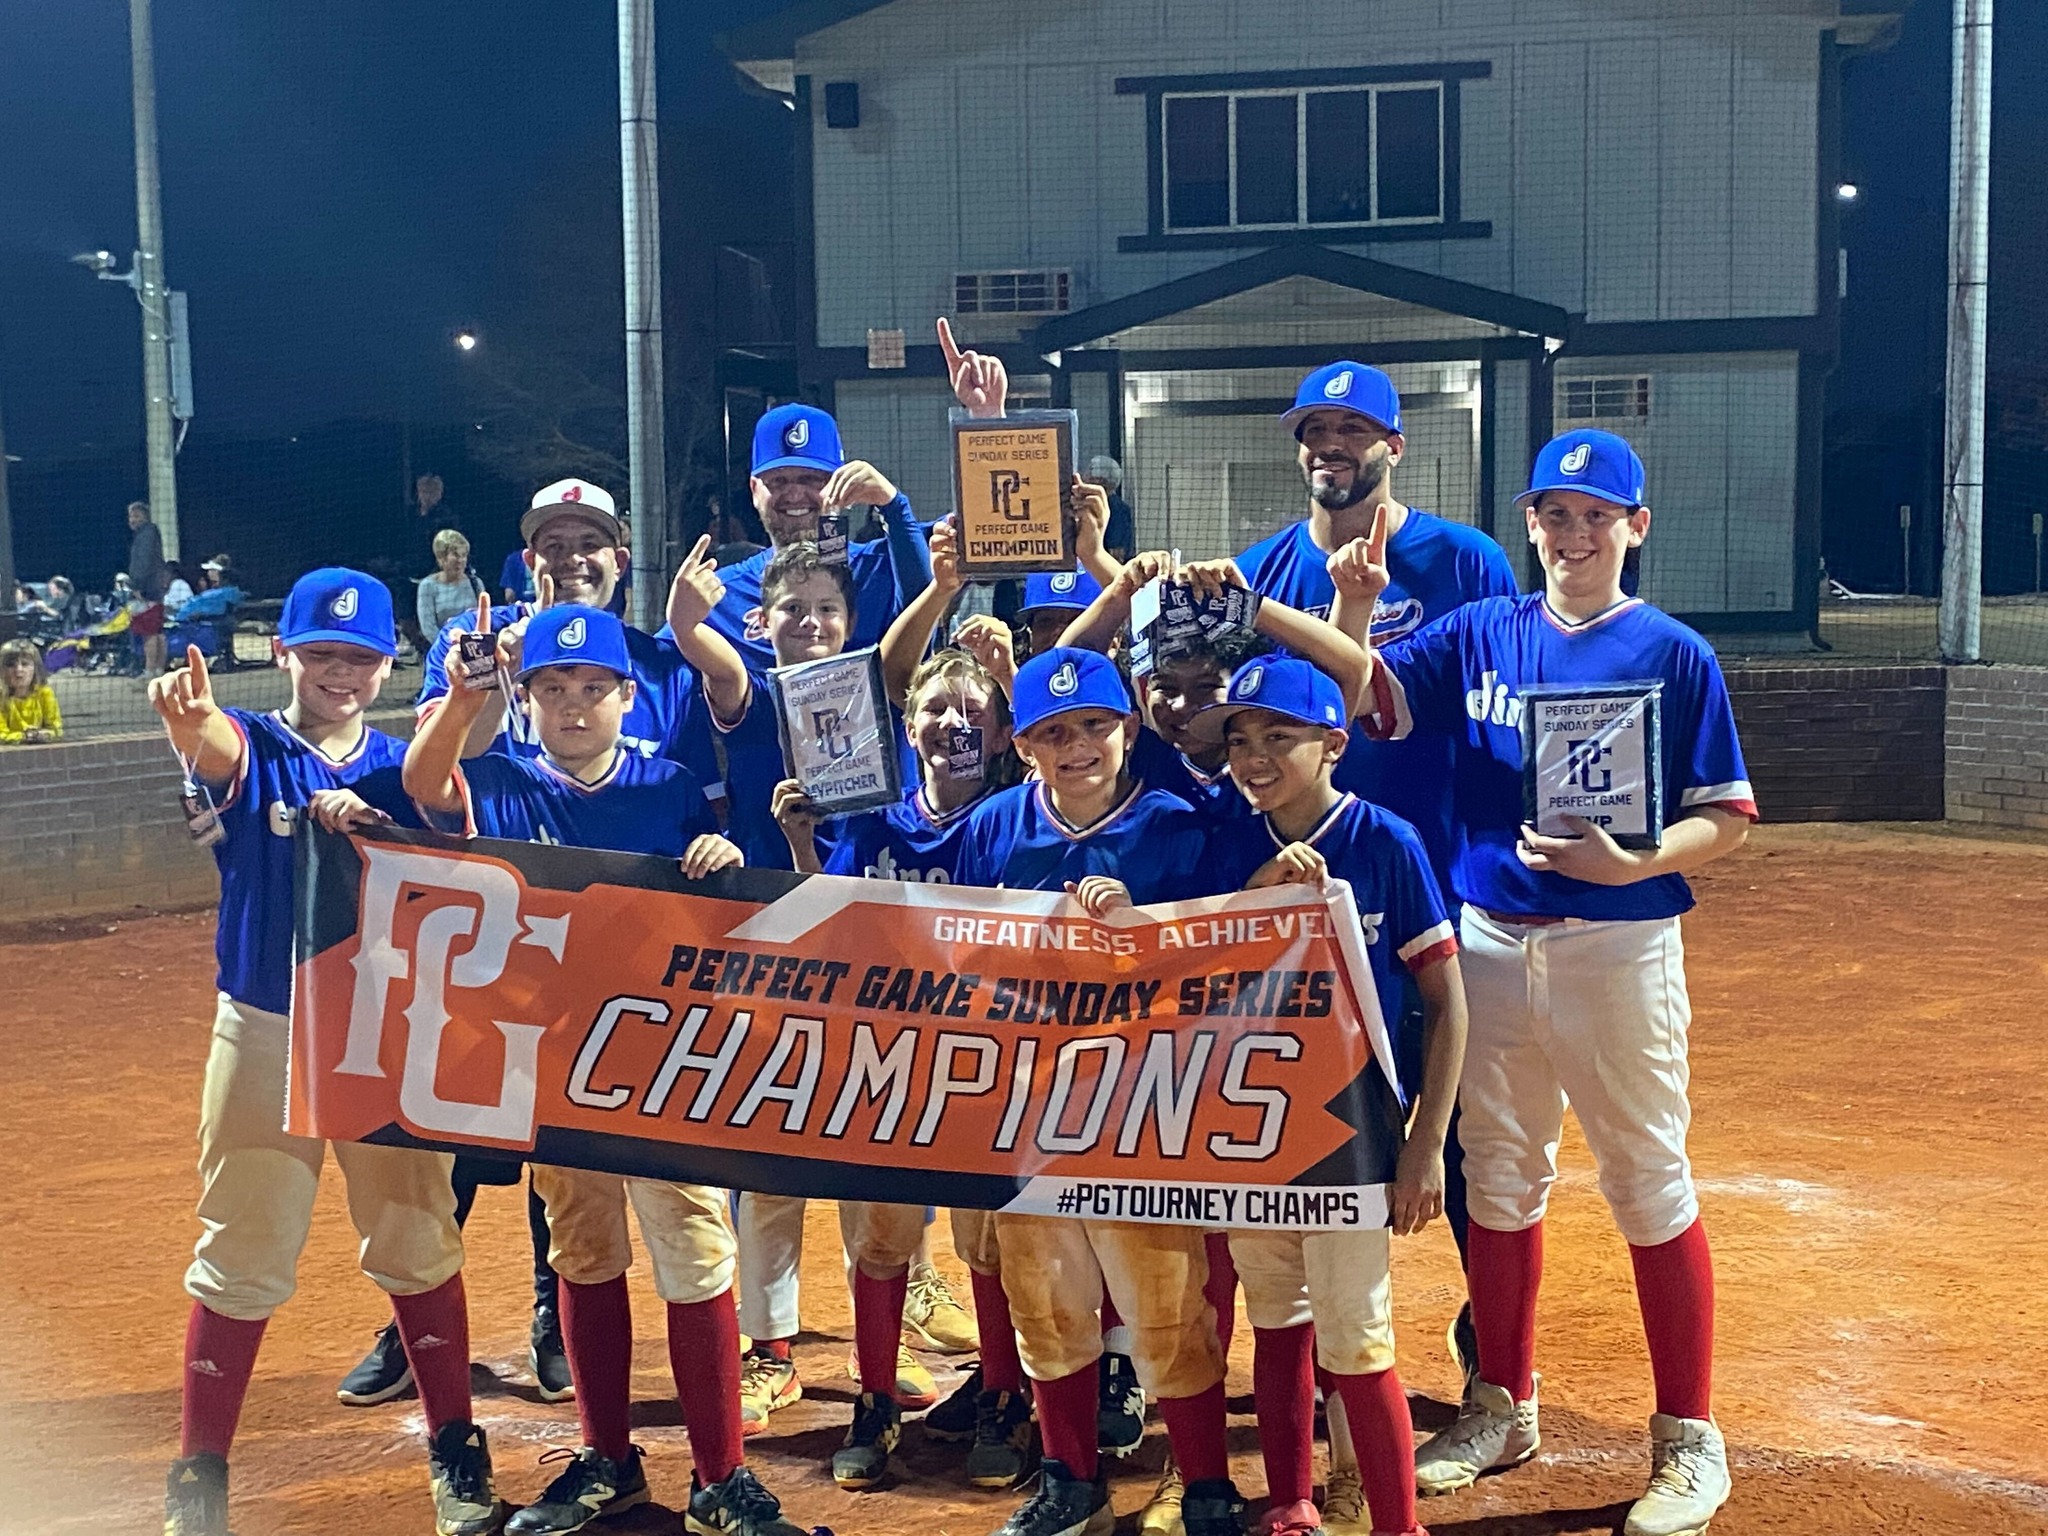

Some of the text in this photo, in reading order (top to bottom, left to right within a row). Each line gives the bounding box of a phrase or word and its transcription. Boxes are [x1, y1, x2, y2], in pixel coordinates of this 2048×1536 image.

[968, 434, 1046, 446] PERFECT GAME
[968, 450, 1049, 462] SUNDAY SERIES
[975, 523, 1049, 535] PERFECT GAME
[970, 539, 1058, 557] CHAMPION
[792, 691, 826, 707] SUNDAY
[1545, 704, 1596, 717] PERFECT
[1544, 720, 1589, 732] SUNDAY
[1549, 794, 1632, 808] PERFECT GAME
[934, 915, 1144, 956] GREATNESS.
[332, 845, 571, 1142] PG
[661, 944, 1336, 1027] PERFECT GAME SUNDAY SERIES
[565, 994, 1305, 1162] CHAMPIONS
[1056, 1182, 1360, 1225] #PGTOURNEY CHAMPS
